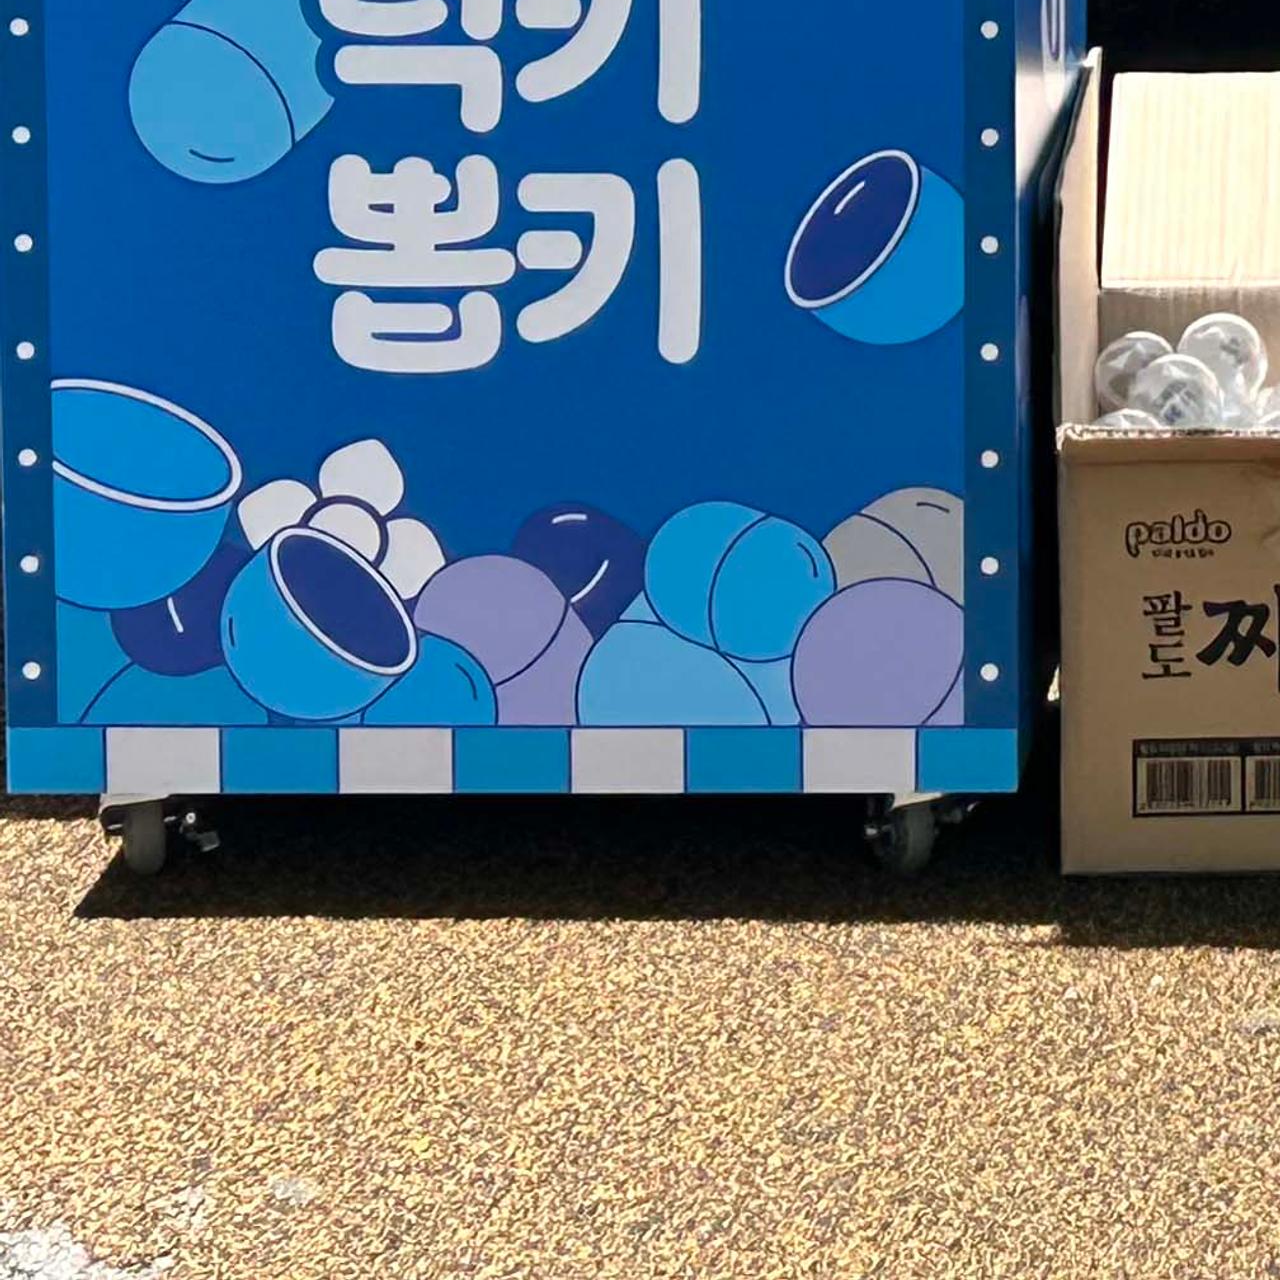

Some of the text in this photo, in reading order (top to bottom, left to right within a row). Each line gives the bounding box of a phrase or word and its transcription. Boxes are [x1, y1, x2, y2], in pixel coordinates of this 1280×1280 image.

[313, 153, 701, 375] 뽑키
[1125, 508, 1232, 558] paldo
[1142, 589, 1193, 681] 팔도
